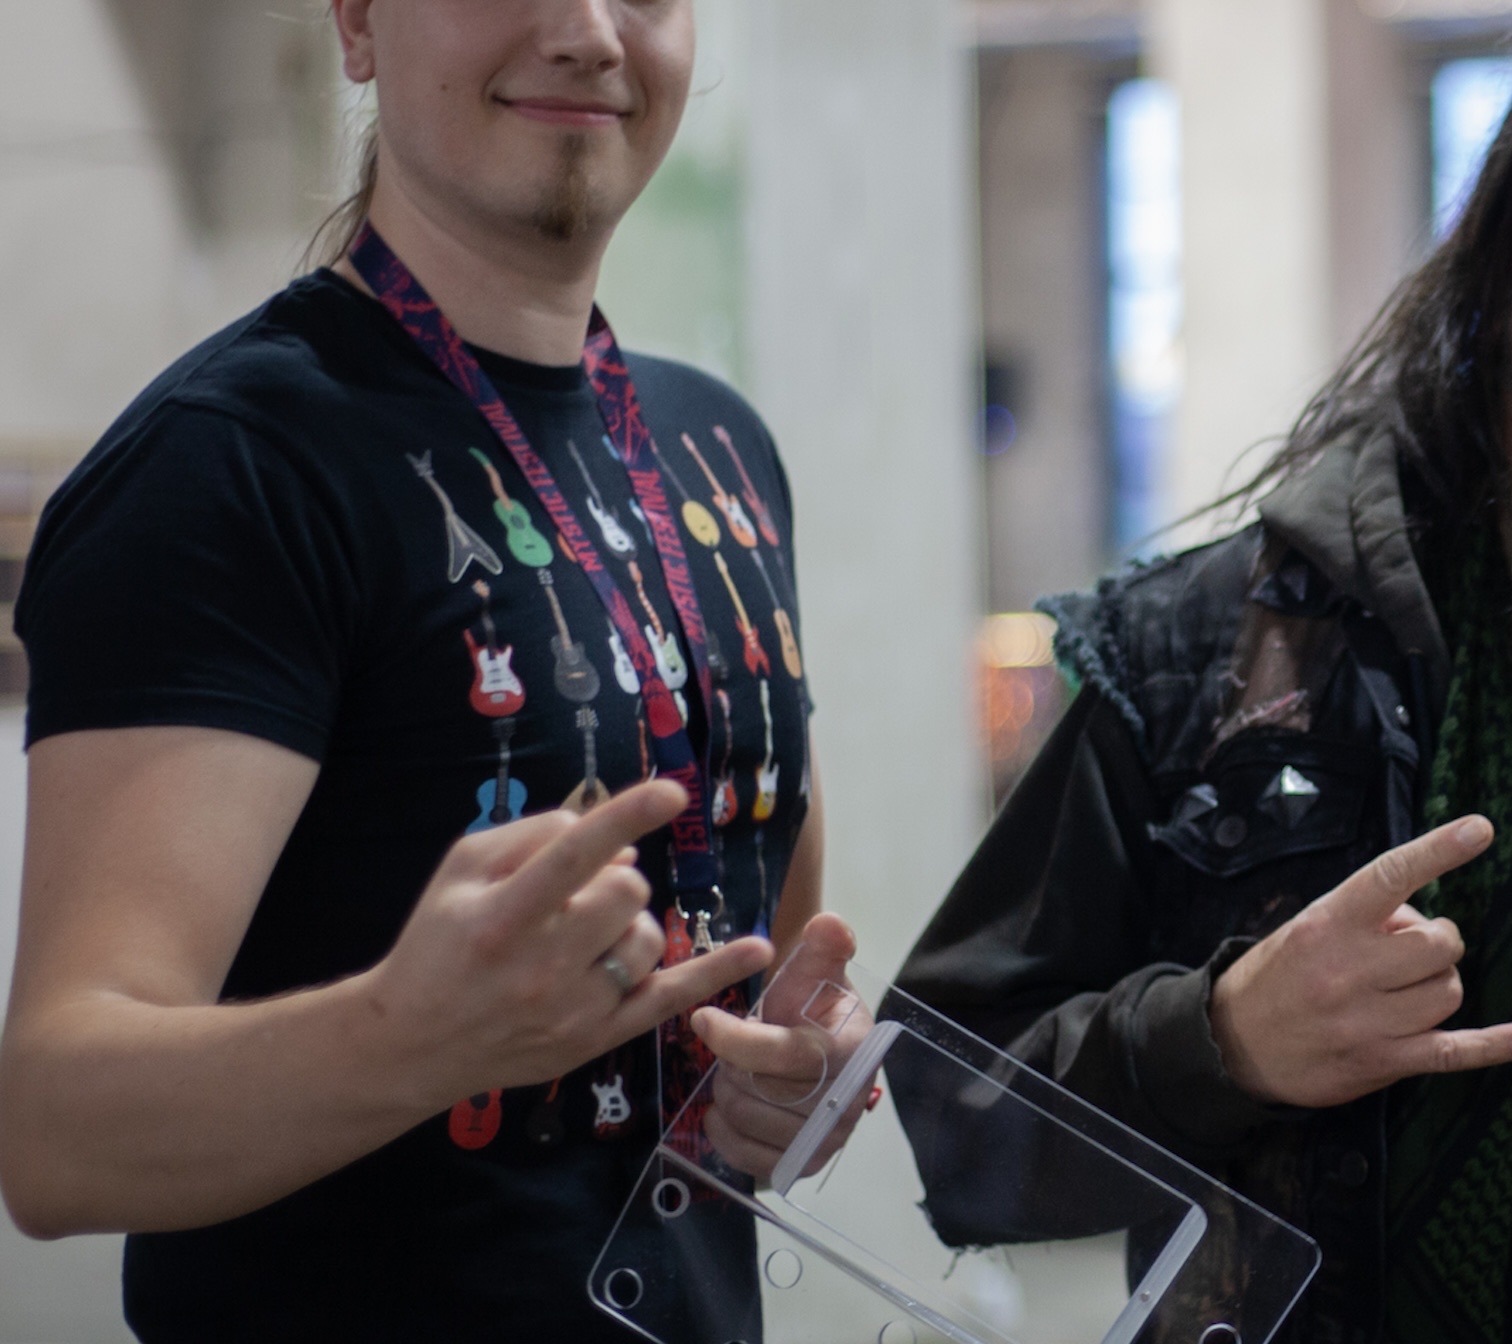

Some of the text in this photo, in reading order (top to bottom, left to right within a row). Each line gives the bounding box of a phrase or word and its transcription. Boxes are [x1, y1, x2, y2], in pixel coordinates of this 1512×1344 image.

[479, 399, 604, 574] MYSTIC FESTIVAL
[628, 468, 705, 645] MYSTIC FESTIVAL
